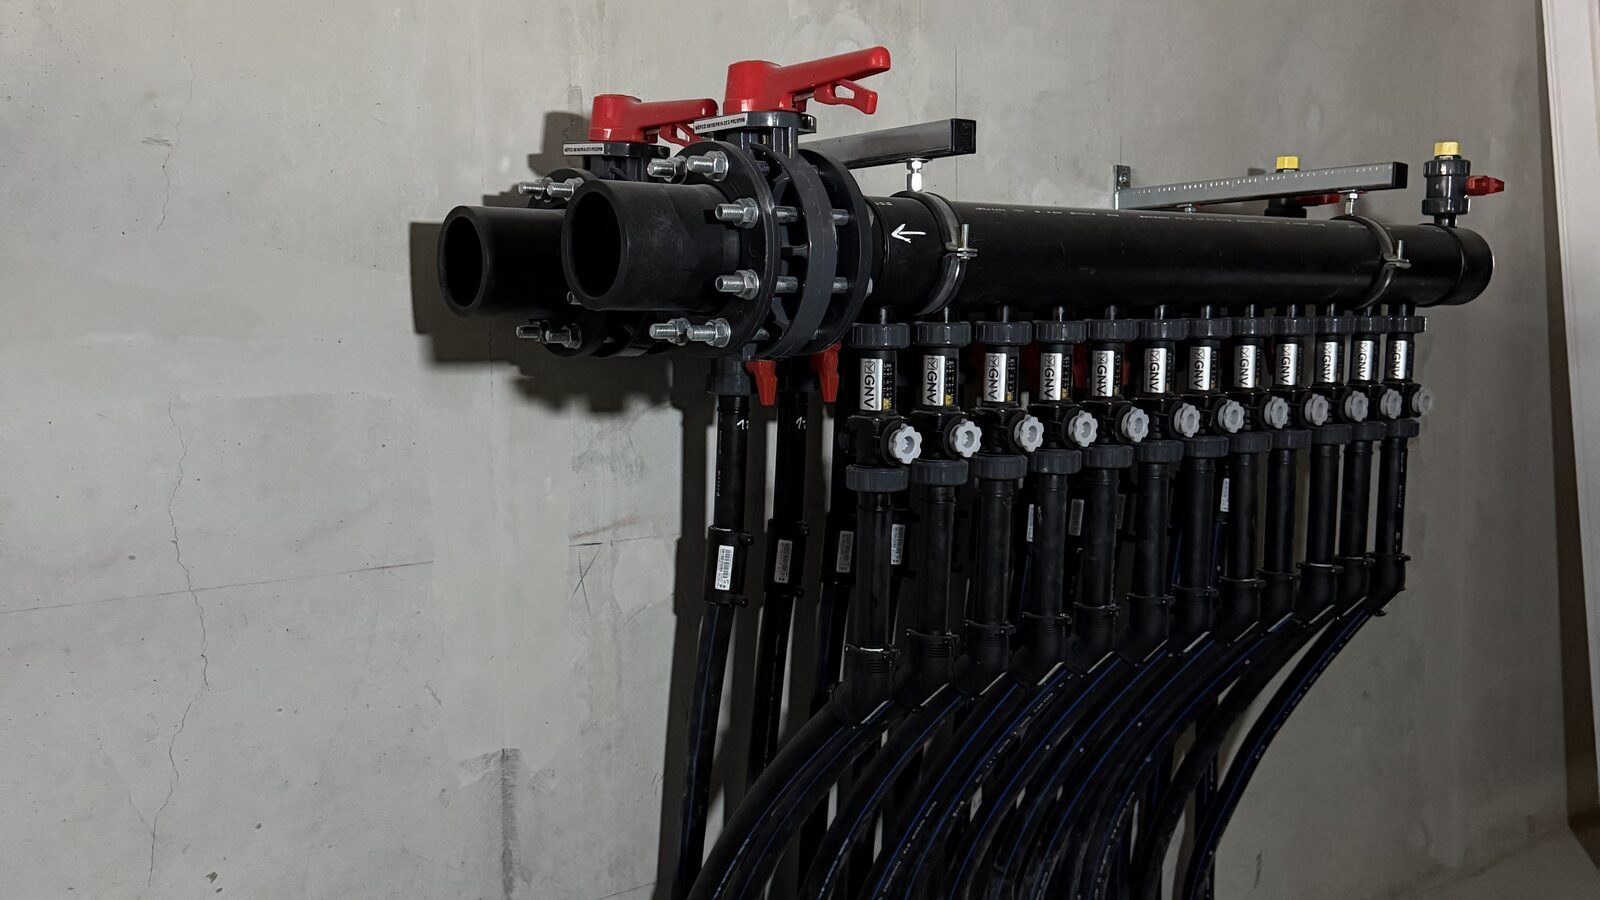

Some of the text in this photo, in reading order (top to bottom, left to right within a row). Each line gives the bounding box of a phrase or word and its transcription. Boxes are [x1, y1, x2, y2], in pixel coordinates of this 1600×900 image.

[988, 368, 998, 400] GNV
[1044, 368, 1055, 398] GNV
[1096, 365, 1107, 395] GNV
[1149, 362, 1160, 391] GNV
[1193, 360, 1204, 388] GNV
[1240, 359, 1250, 386] GNV
[1280, 356, 1291, 383] GNV
[864, 375, 875, 408] GNV
[926, 371, 937, 404] GNV
